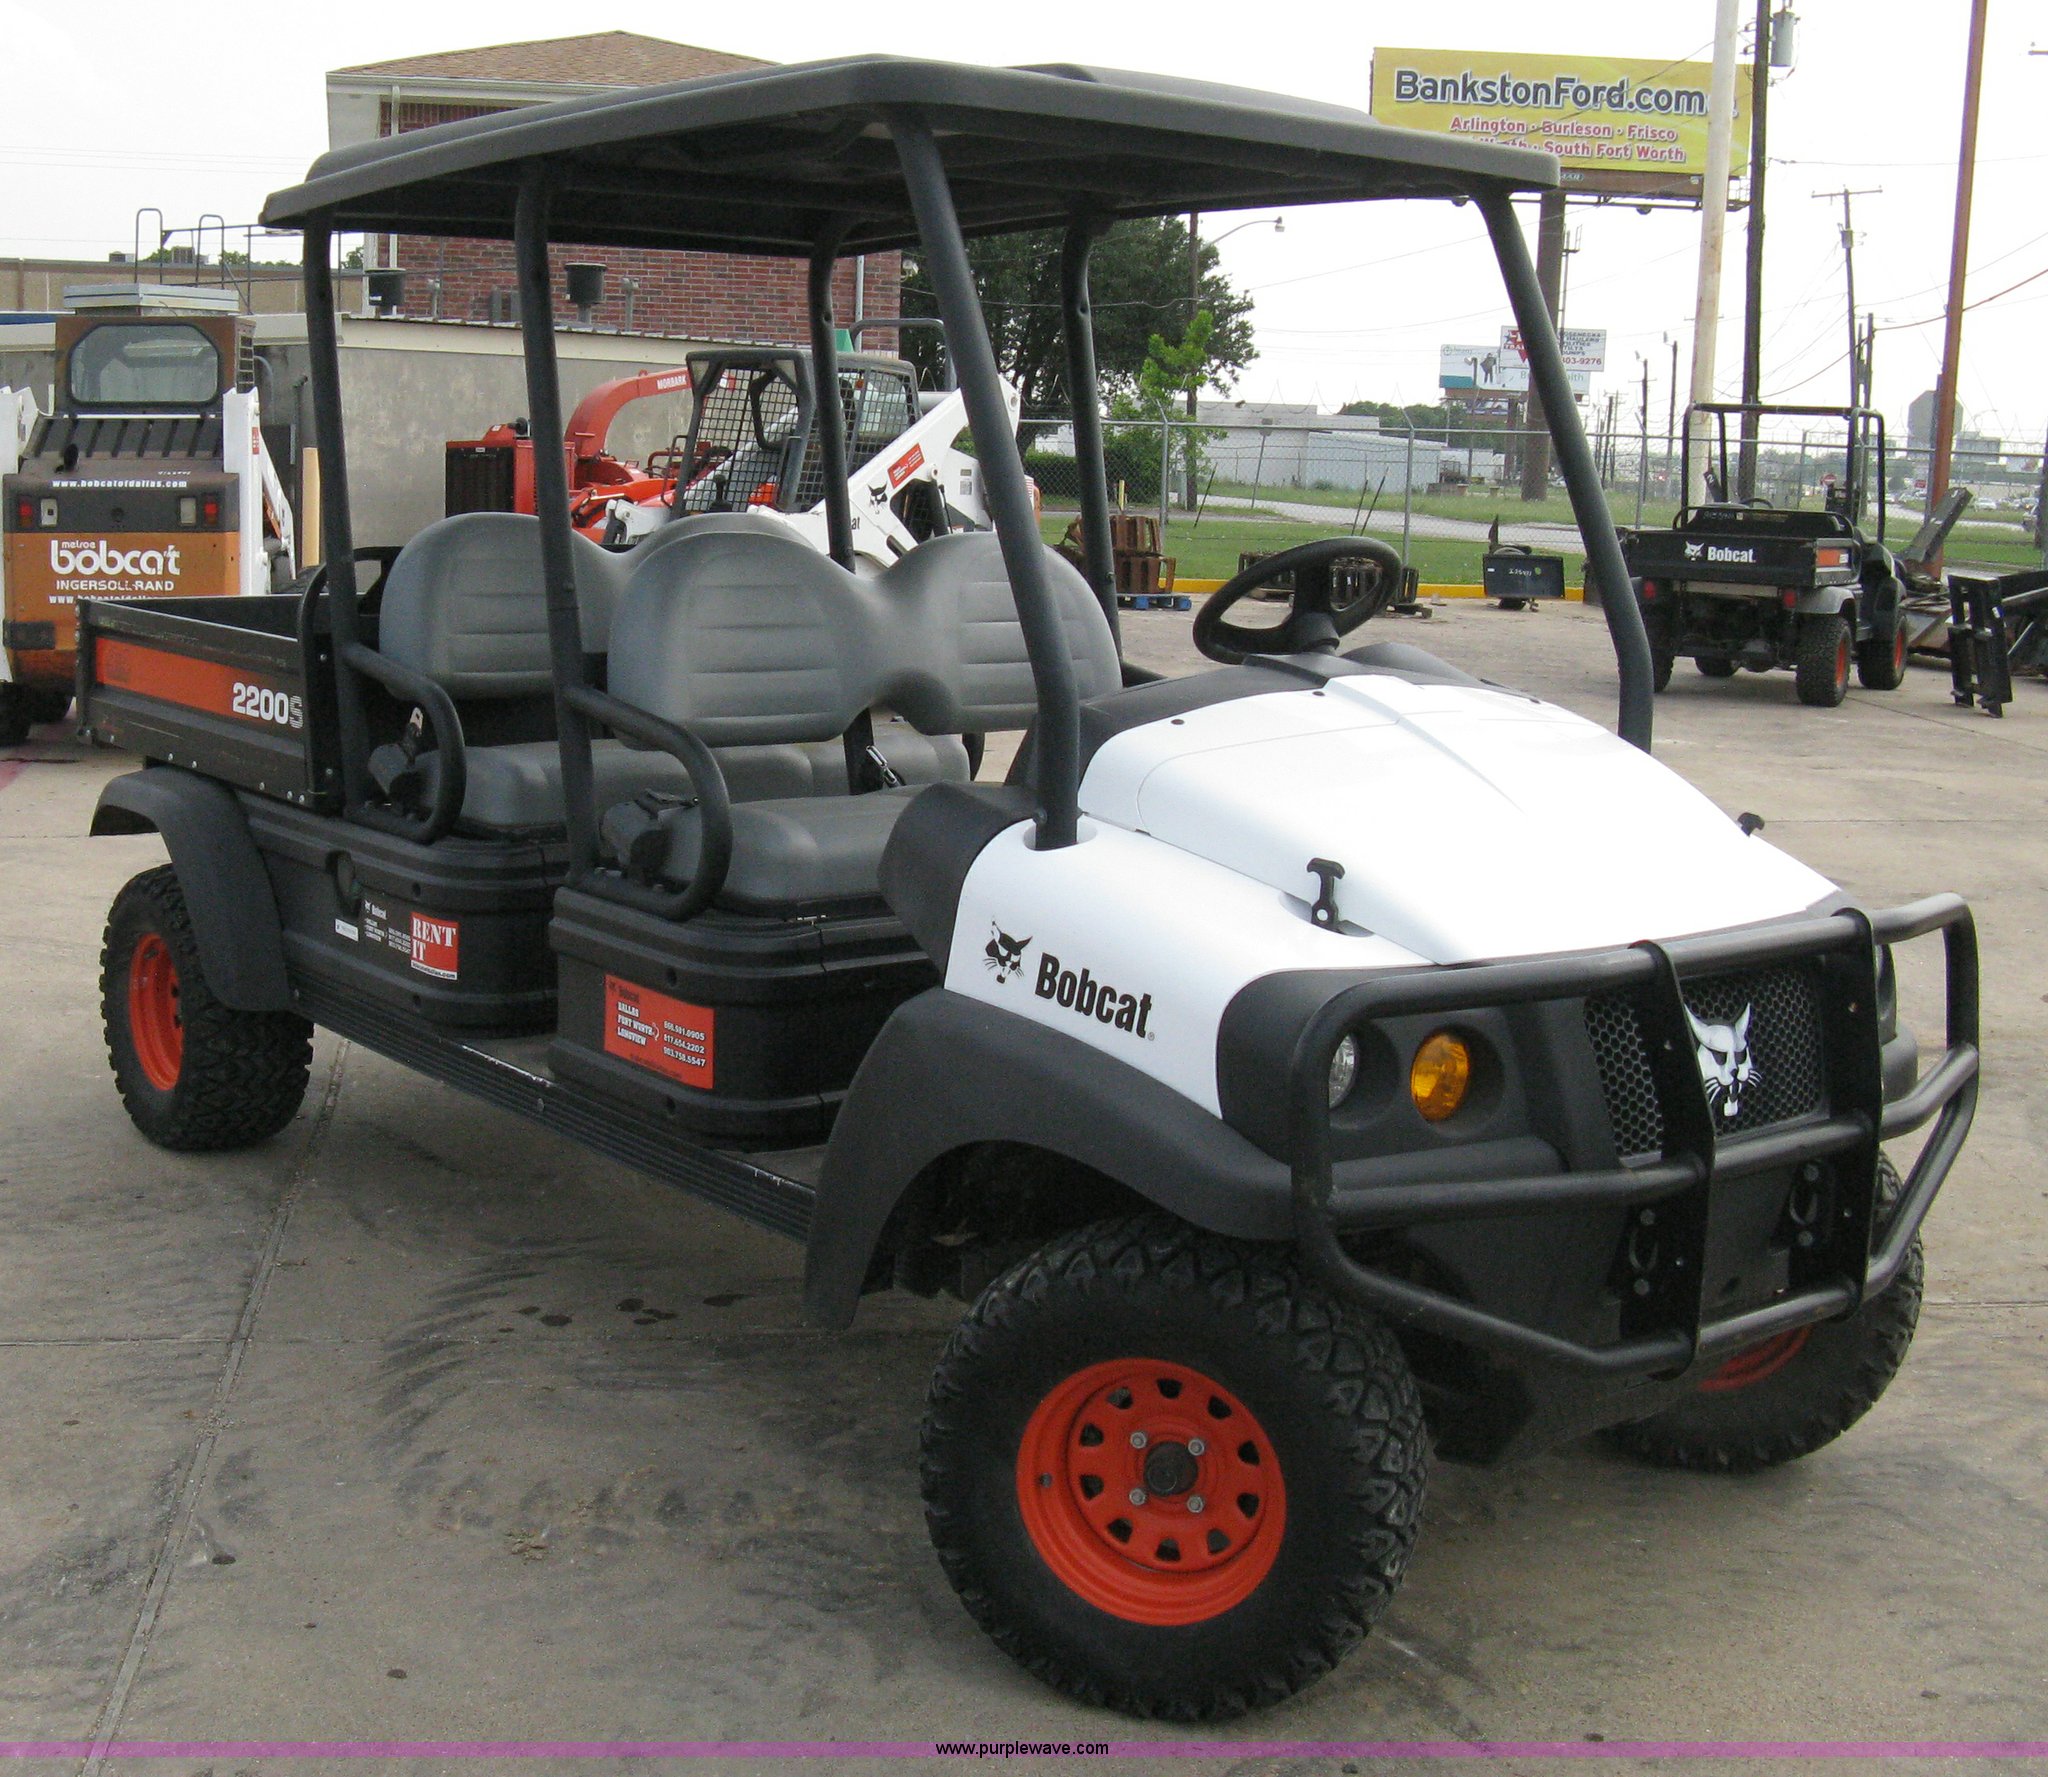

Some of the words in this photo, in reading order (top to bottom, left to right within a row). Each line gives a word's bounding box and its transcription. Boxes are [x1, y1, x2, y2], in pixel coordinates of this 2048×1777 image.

[1395, 69, 1704, 114] BankstonFord.com
[1450, 116, 1526, 136] Arlington
[1541, 120, 1611, 138] Burleson
[1627, 125, 1677, 141] Frisco
[1543, 140, 1591, 156] South
[1596, 144, 1632, 159] Fort
[1636, 145, 1685, 162] Worth
[61, 540, 96, 549] melroe
[1707, 546, 1754, 563] Bobcat
[50, 540, 180, 576] bobcat
[413, 916, 457, 948] RENT
[412, 938, 426, 961] IT
[1035, 952, 1152, 1038] Bobcat
